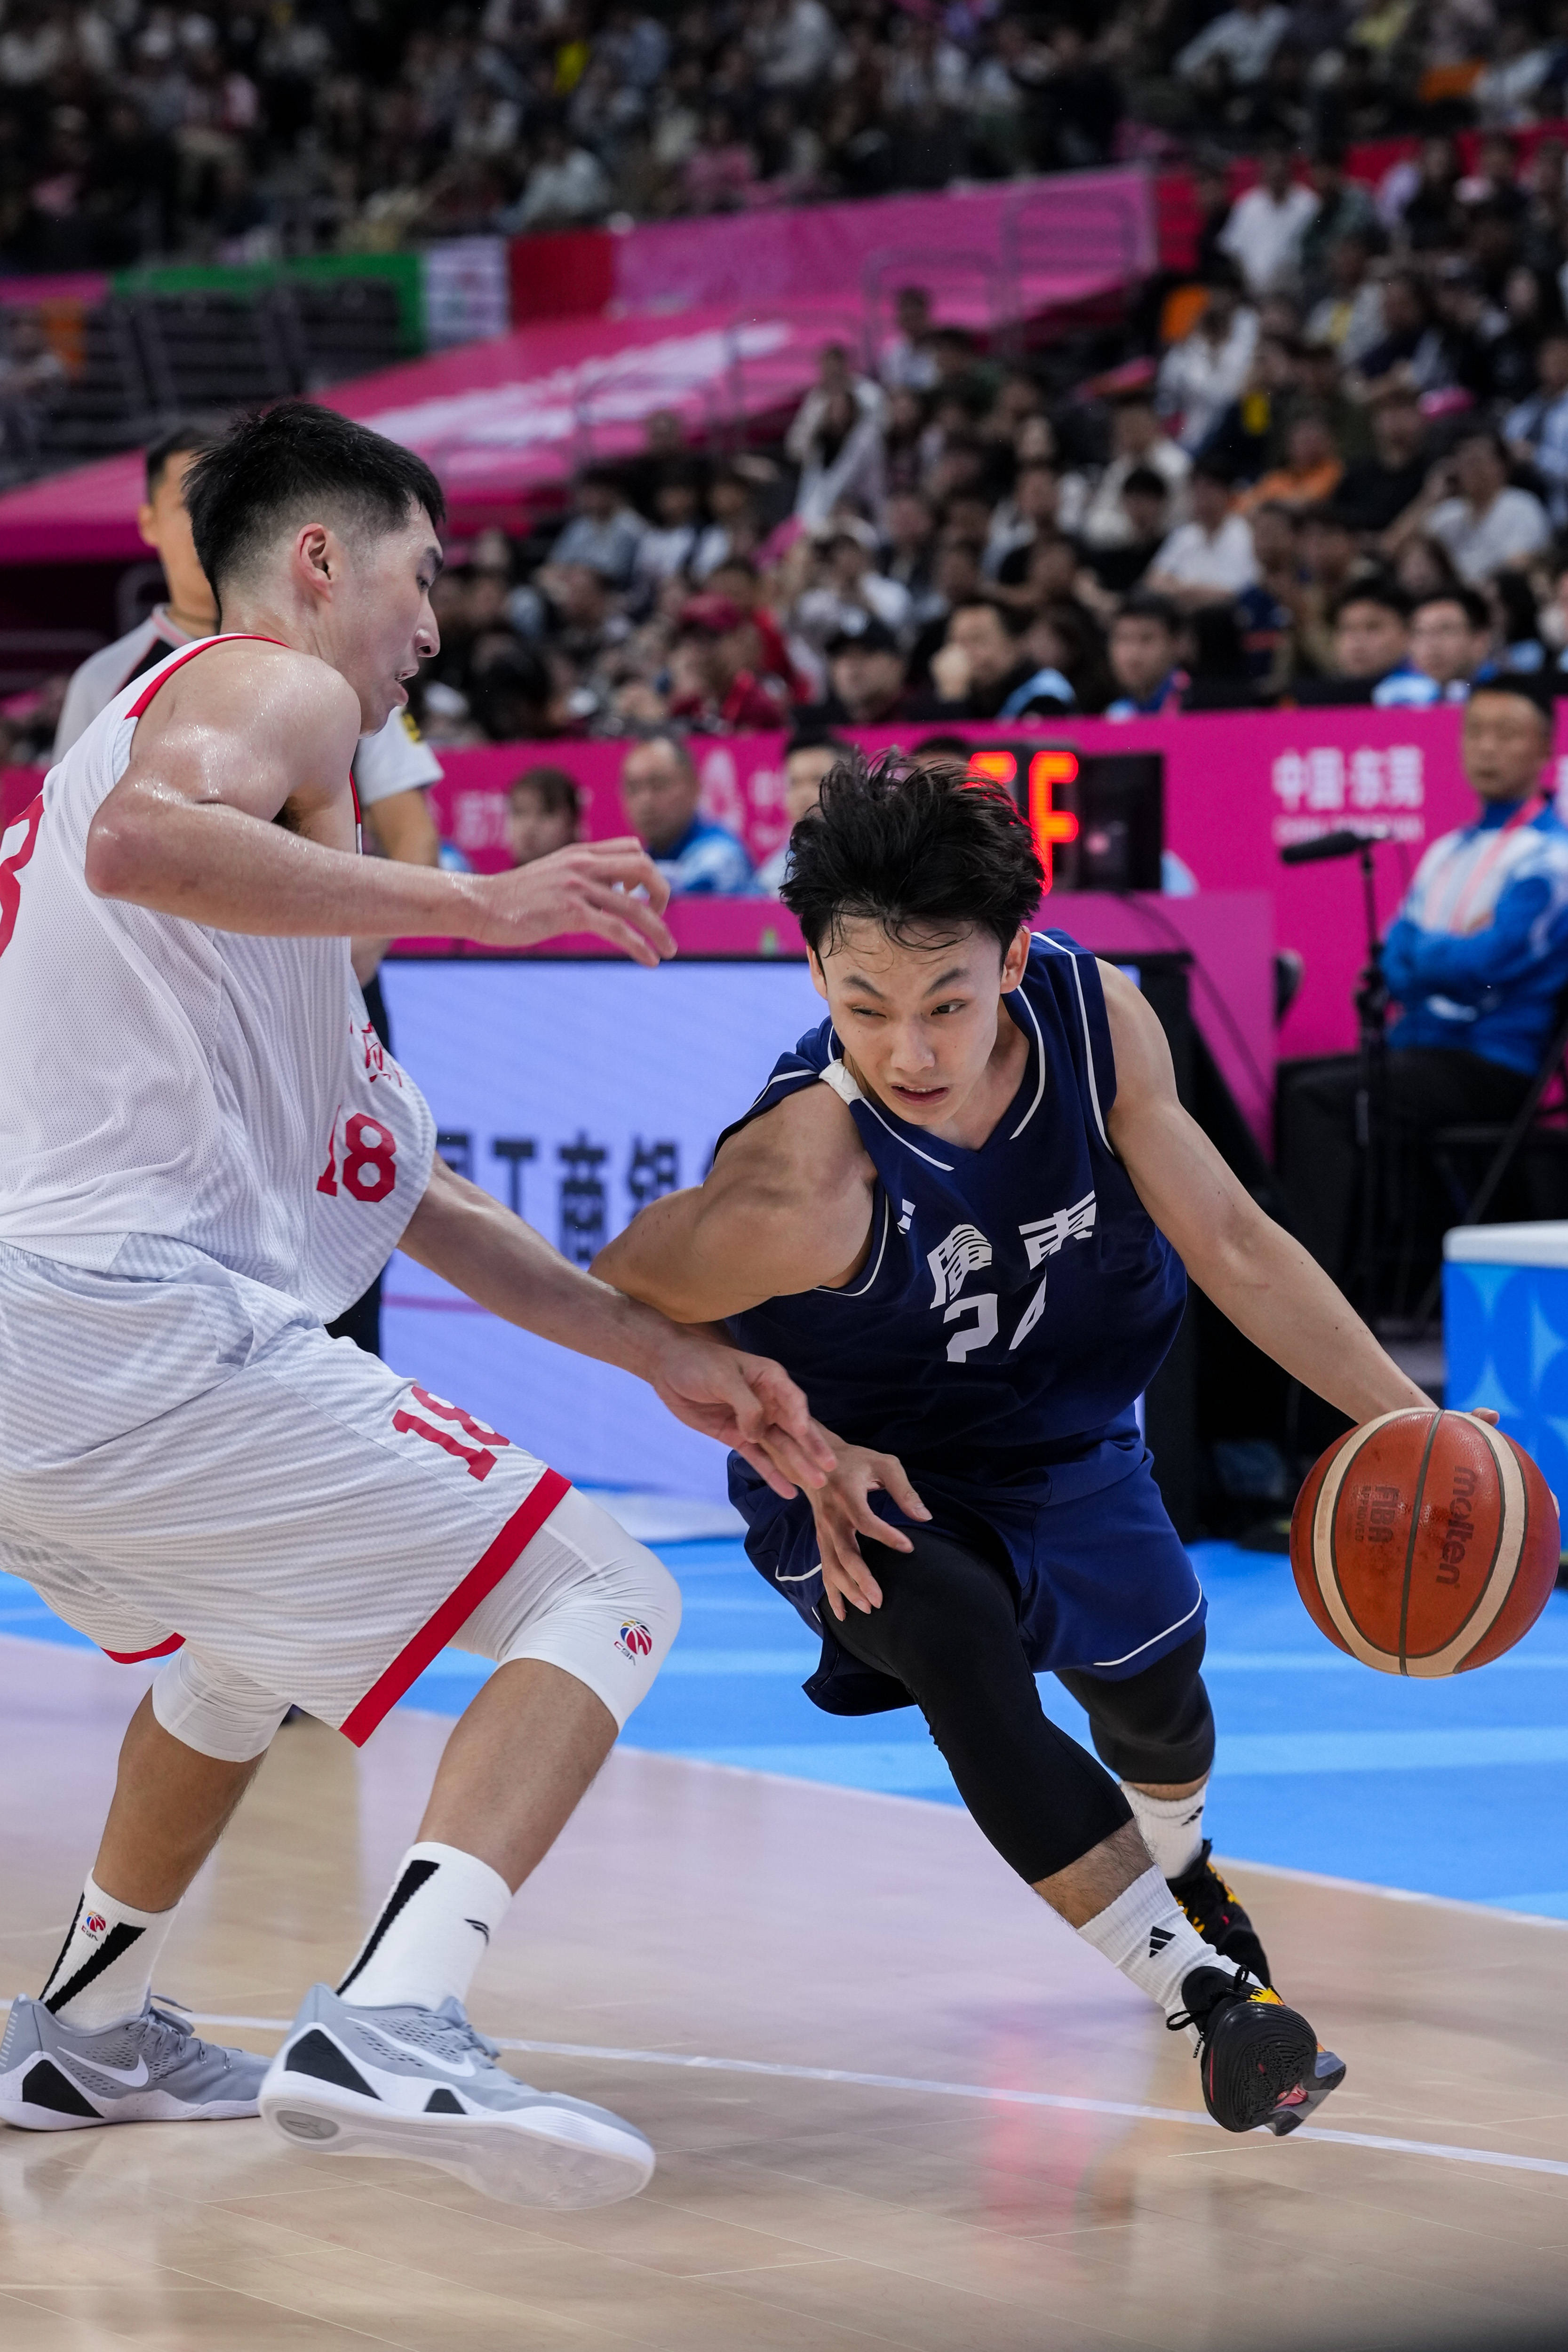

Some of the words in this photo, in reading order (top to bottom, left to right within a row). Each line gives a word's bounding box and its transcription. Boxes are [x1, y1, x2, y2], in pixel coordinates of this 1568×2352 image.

[316, 1104, 397, 1202] 18
[392, 1385, 510, 1482] 18
[1368, 1486, 1400, 1542] FIBA
[1436, 1465, 1478, 1585] molten
